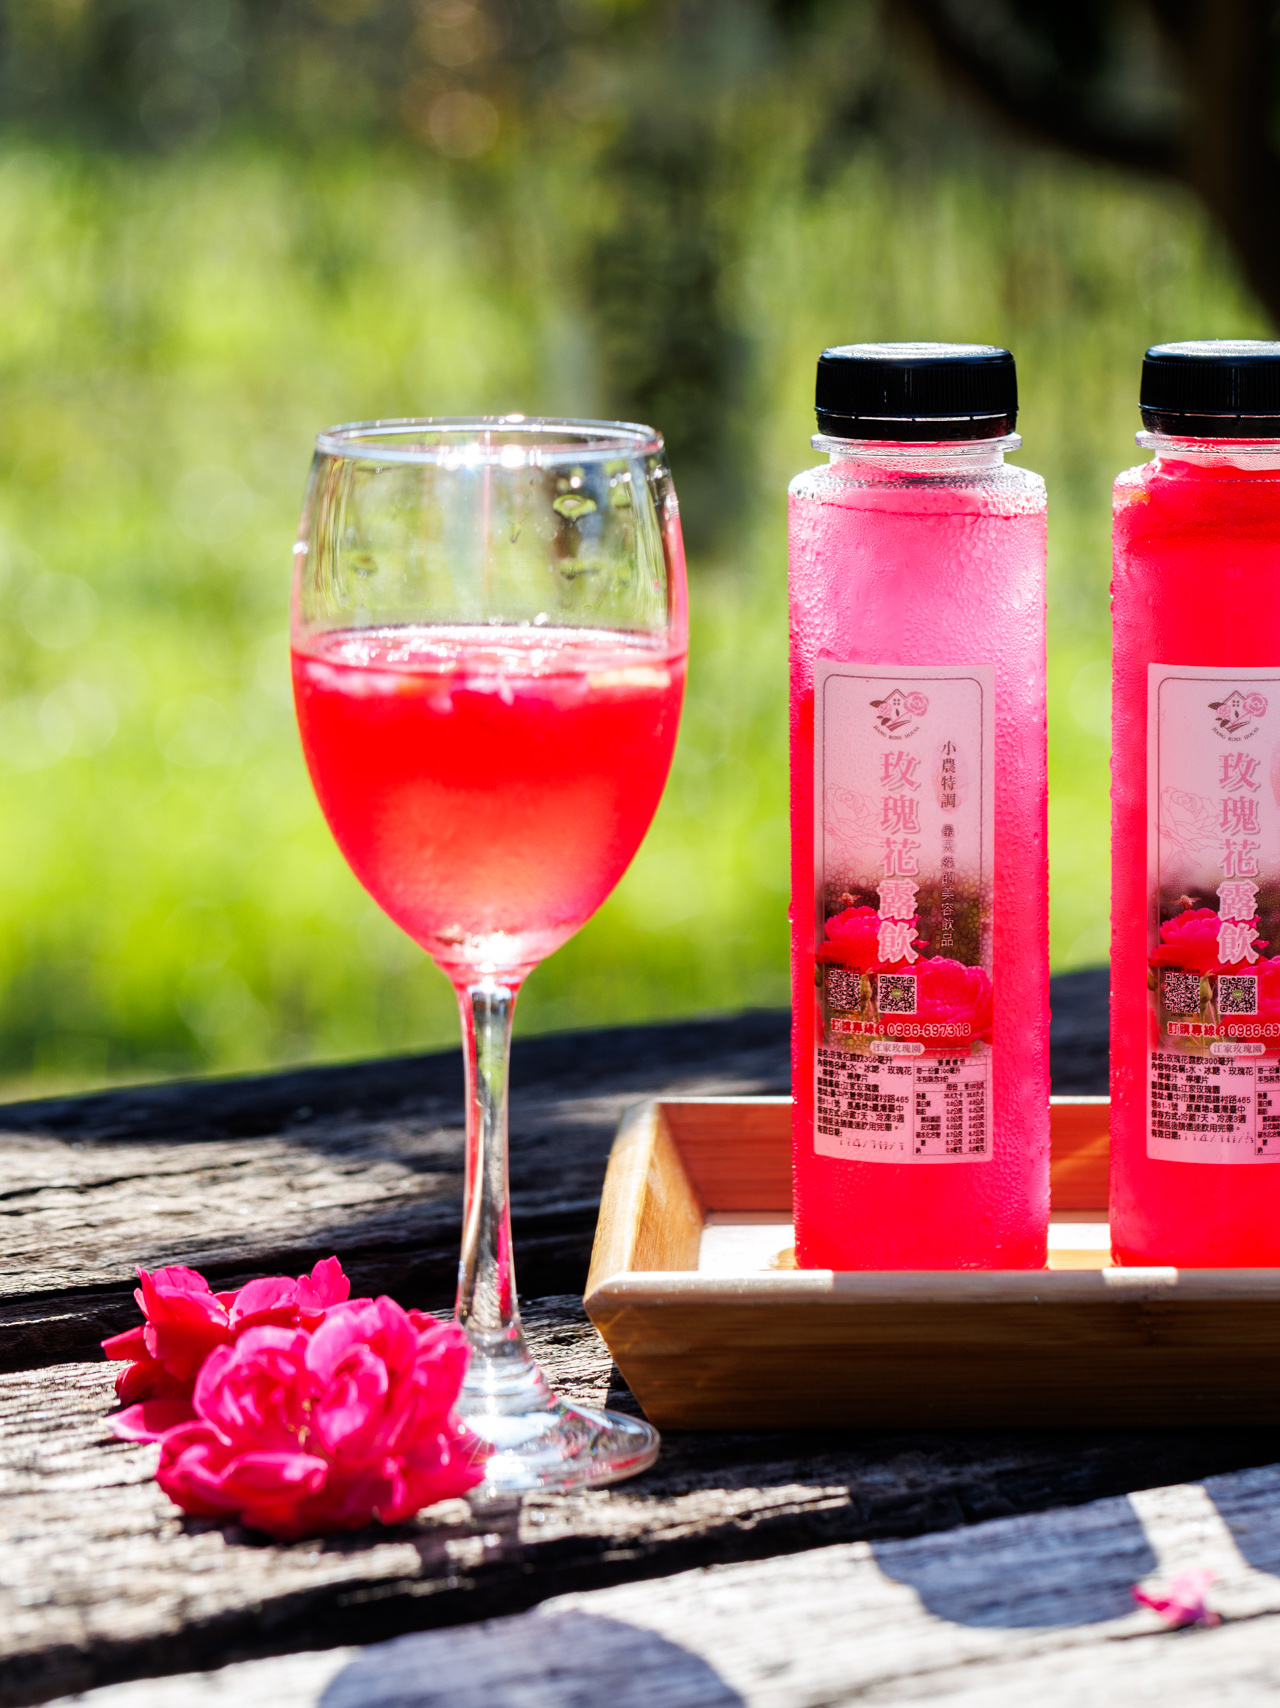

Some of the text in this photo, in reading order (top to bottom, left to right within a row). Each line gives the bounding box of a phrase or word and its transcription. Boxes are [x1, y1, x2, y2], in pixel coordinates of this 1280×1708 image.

[940, 741, 956, 808] 小農特調
[878, 750, 921, 964] 玫瑰花露飲
[1216, 752, 1260, 964] 玫瑰花露飲
[1214, 1044, 1262, 1054] 江家玫瑰園
